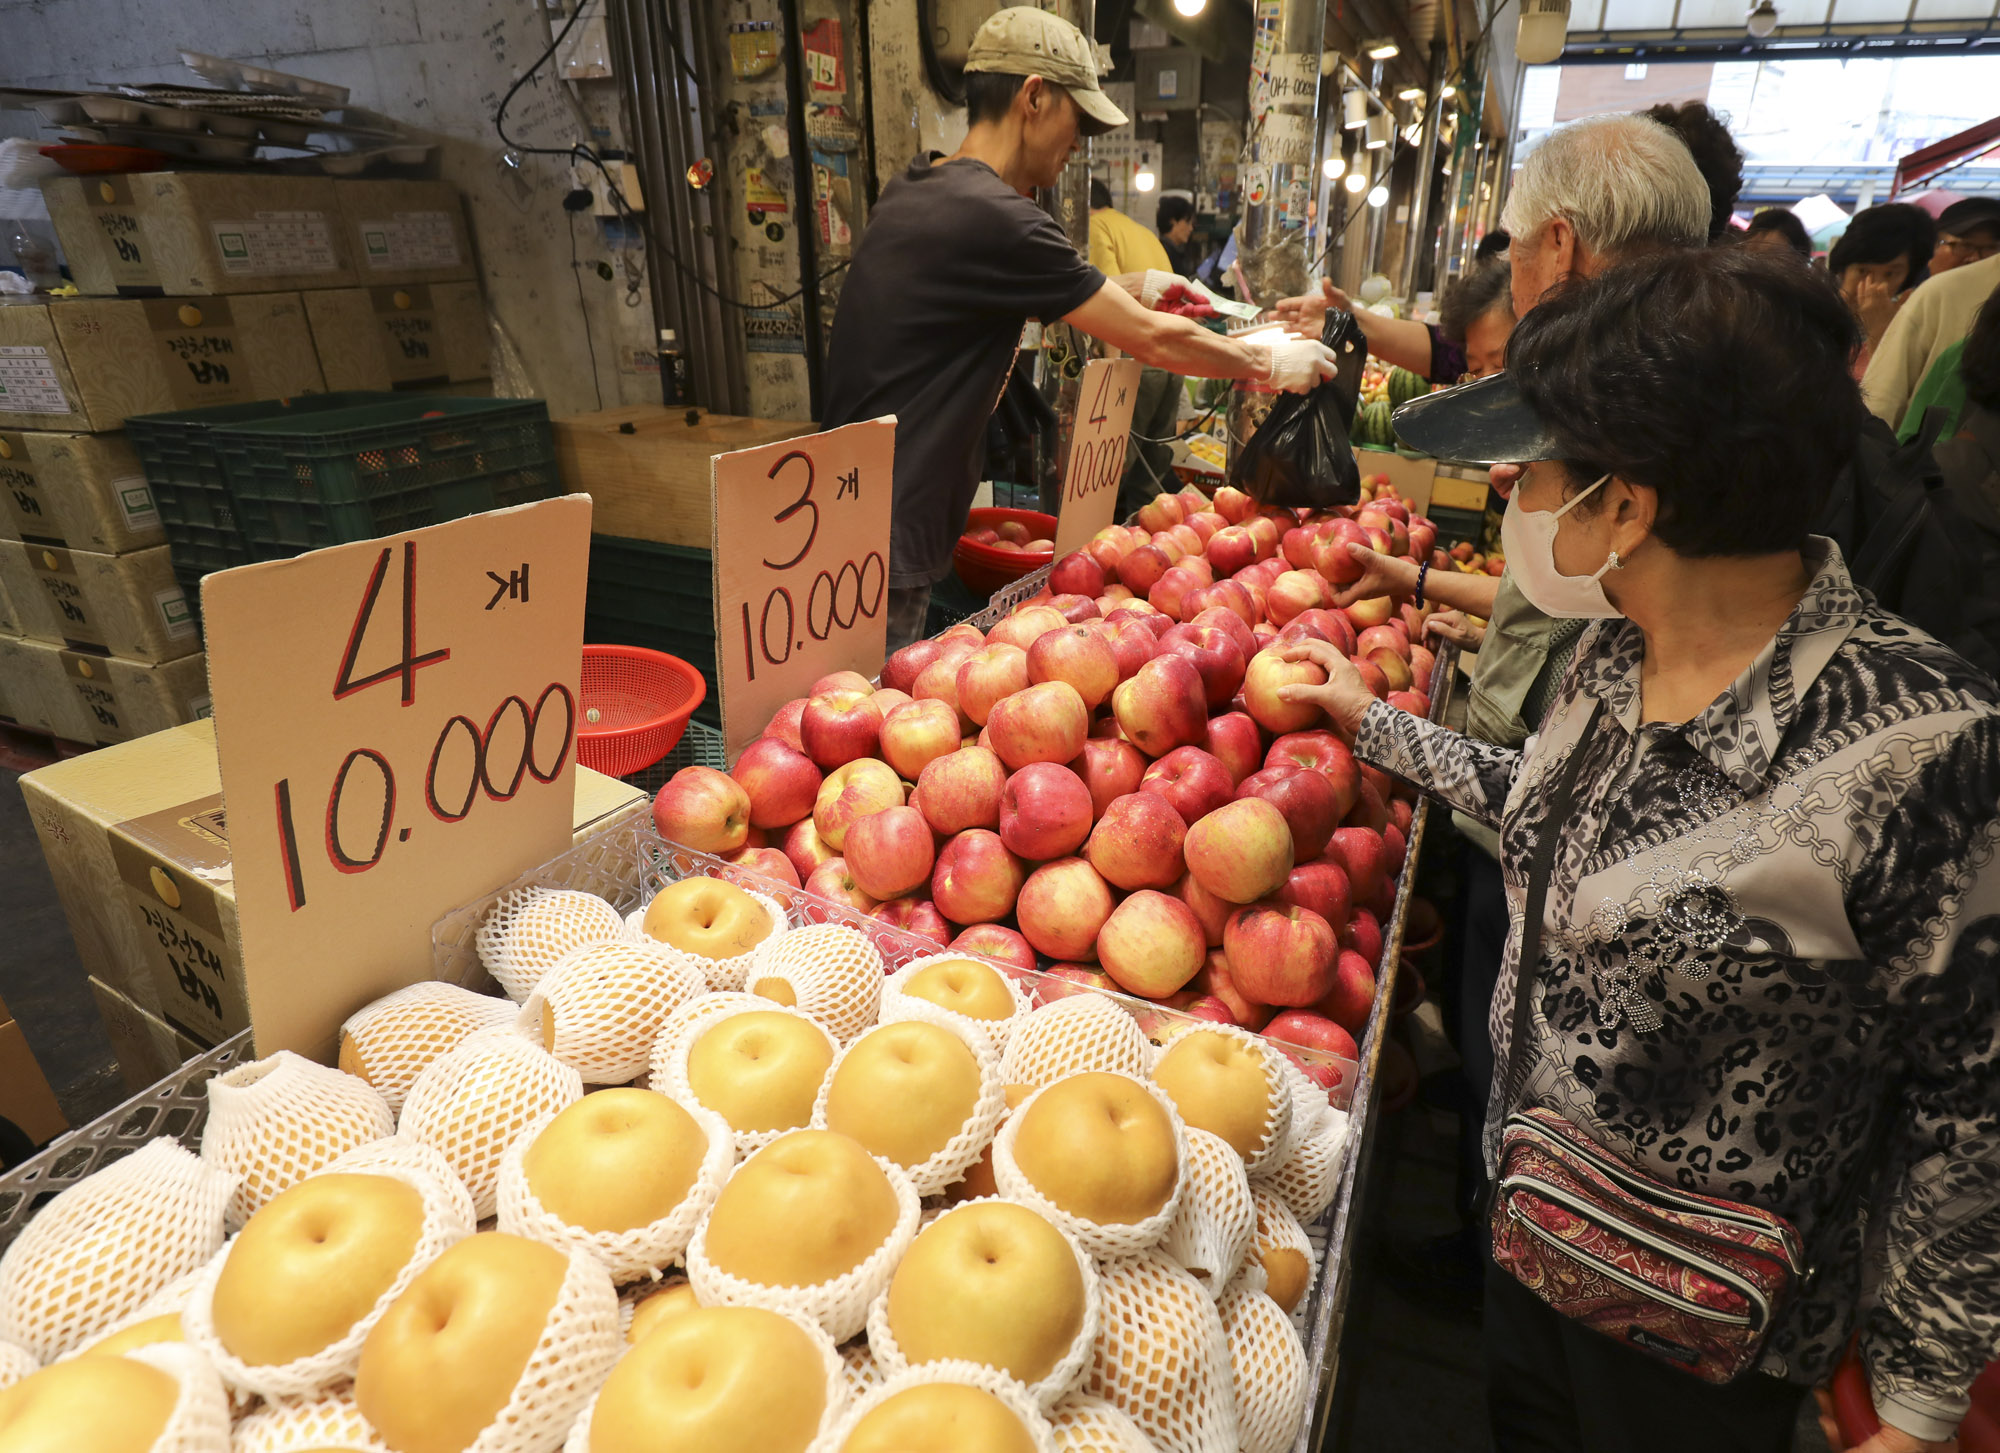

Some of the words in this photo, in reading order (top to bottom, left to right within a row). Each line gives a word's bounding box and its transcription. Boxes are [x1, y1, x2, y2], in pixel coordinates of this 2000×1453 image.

[113, 237, 141, 263] 배
[166, 336, 234, 360] 경천대
[187, 360, 231, 385] 배
[1088, 363, 1114, 434] 4
[1068, 434, 1125, 503] 10.000
[13, 491, 42, 516] 배
[763, 450, 820, 570] 3
[836, 466, 859, 500] 개
[58, 600, 86, 624] 배
[333, 540, 451, 707] 4
[484, 562, 530, 610] 개
[741, 550, 886, 683] 10.000
[91, 704, 119, 728] 배
[273, 682, 575, 913] 10.000
[139, 904, 226, 982] 경천대
[167, 952, 223, 1021] 배
